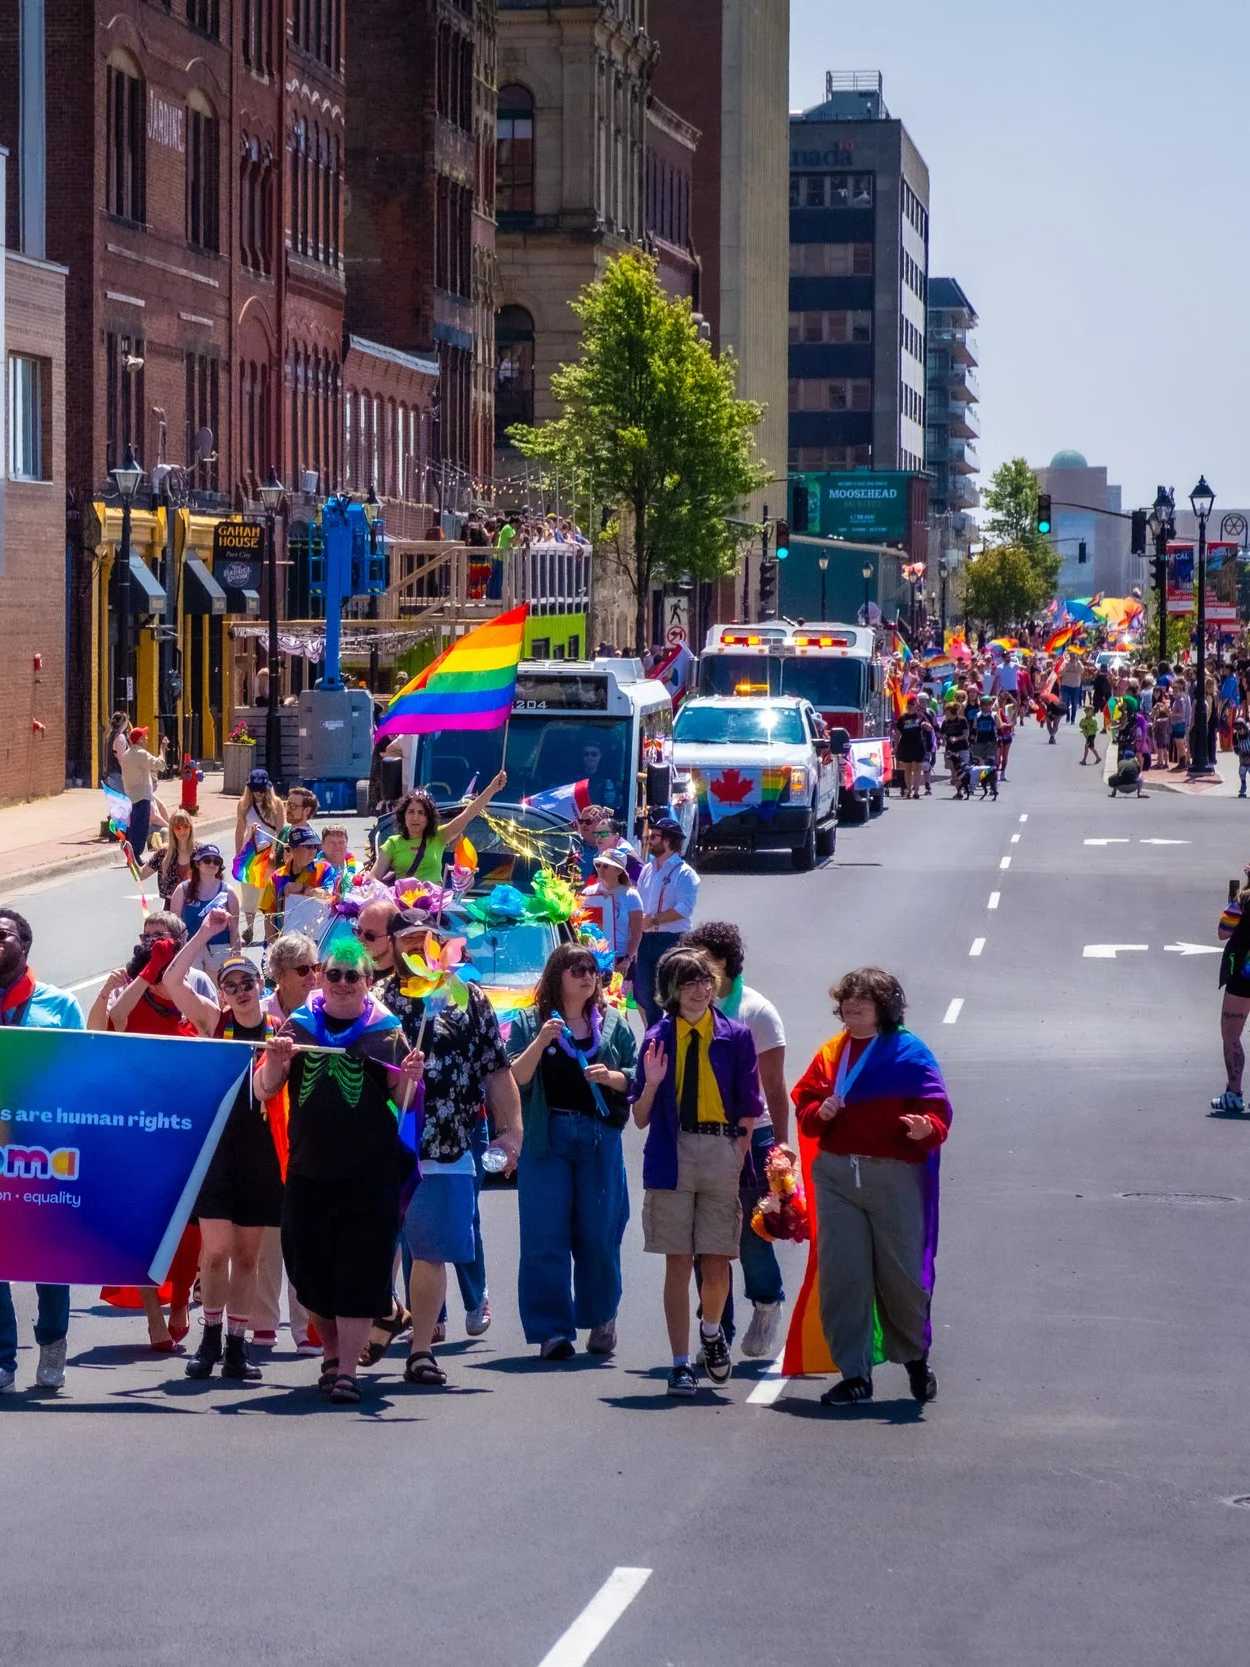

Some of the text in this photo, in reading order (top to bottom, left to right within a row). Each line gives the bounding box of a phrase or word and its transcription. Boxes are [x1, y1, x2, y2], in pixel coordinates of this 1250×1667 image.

[147, 88, 185, 153] JARDINE
[829, 488, 897, 499] MOOSEHEAD
[218, 536, 259, 548] HOUSE
[15, 1107, 53, 1123] are
[56, 1107, 125, 1127] human
[128, 1110, 193, 1133] rights
[23, 1190, 81, 1208] equality
